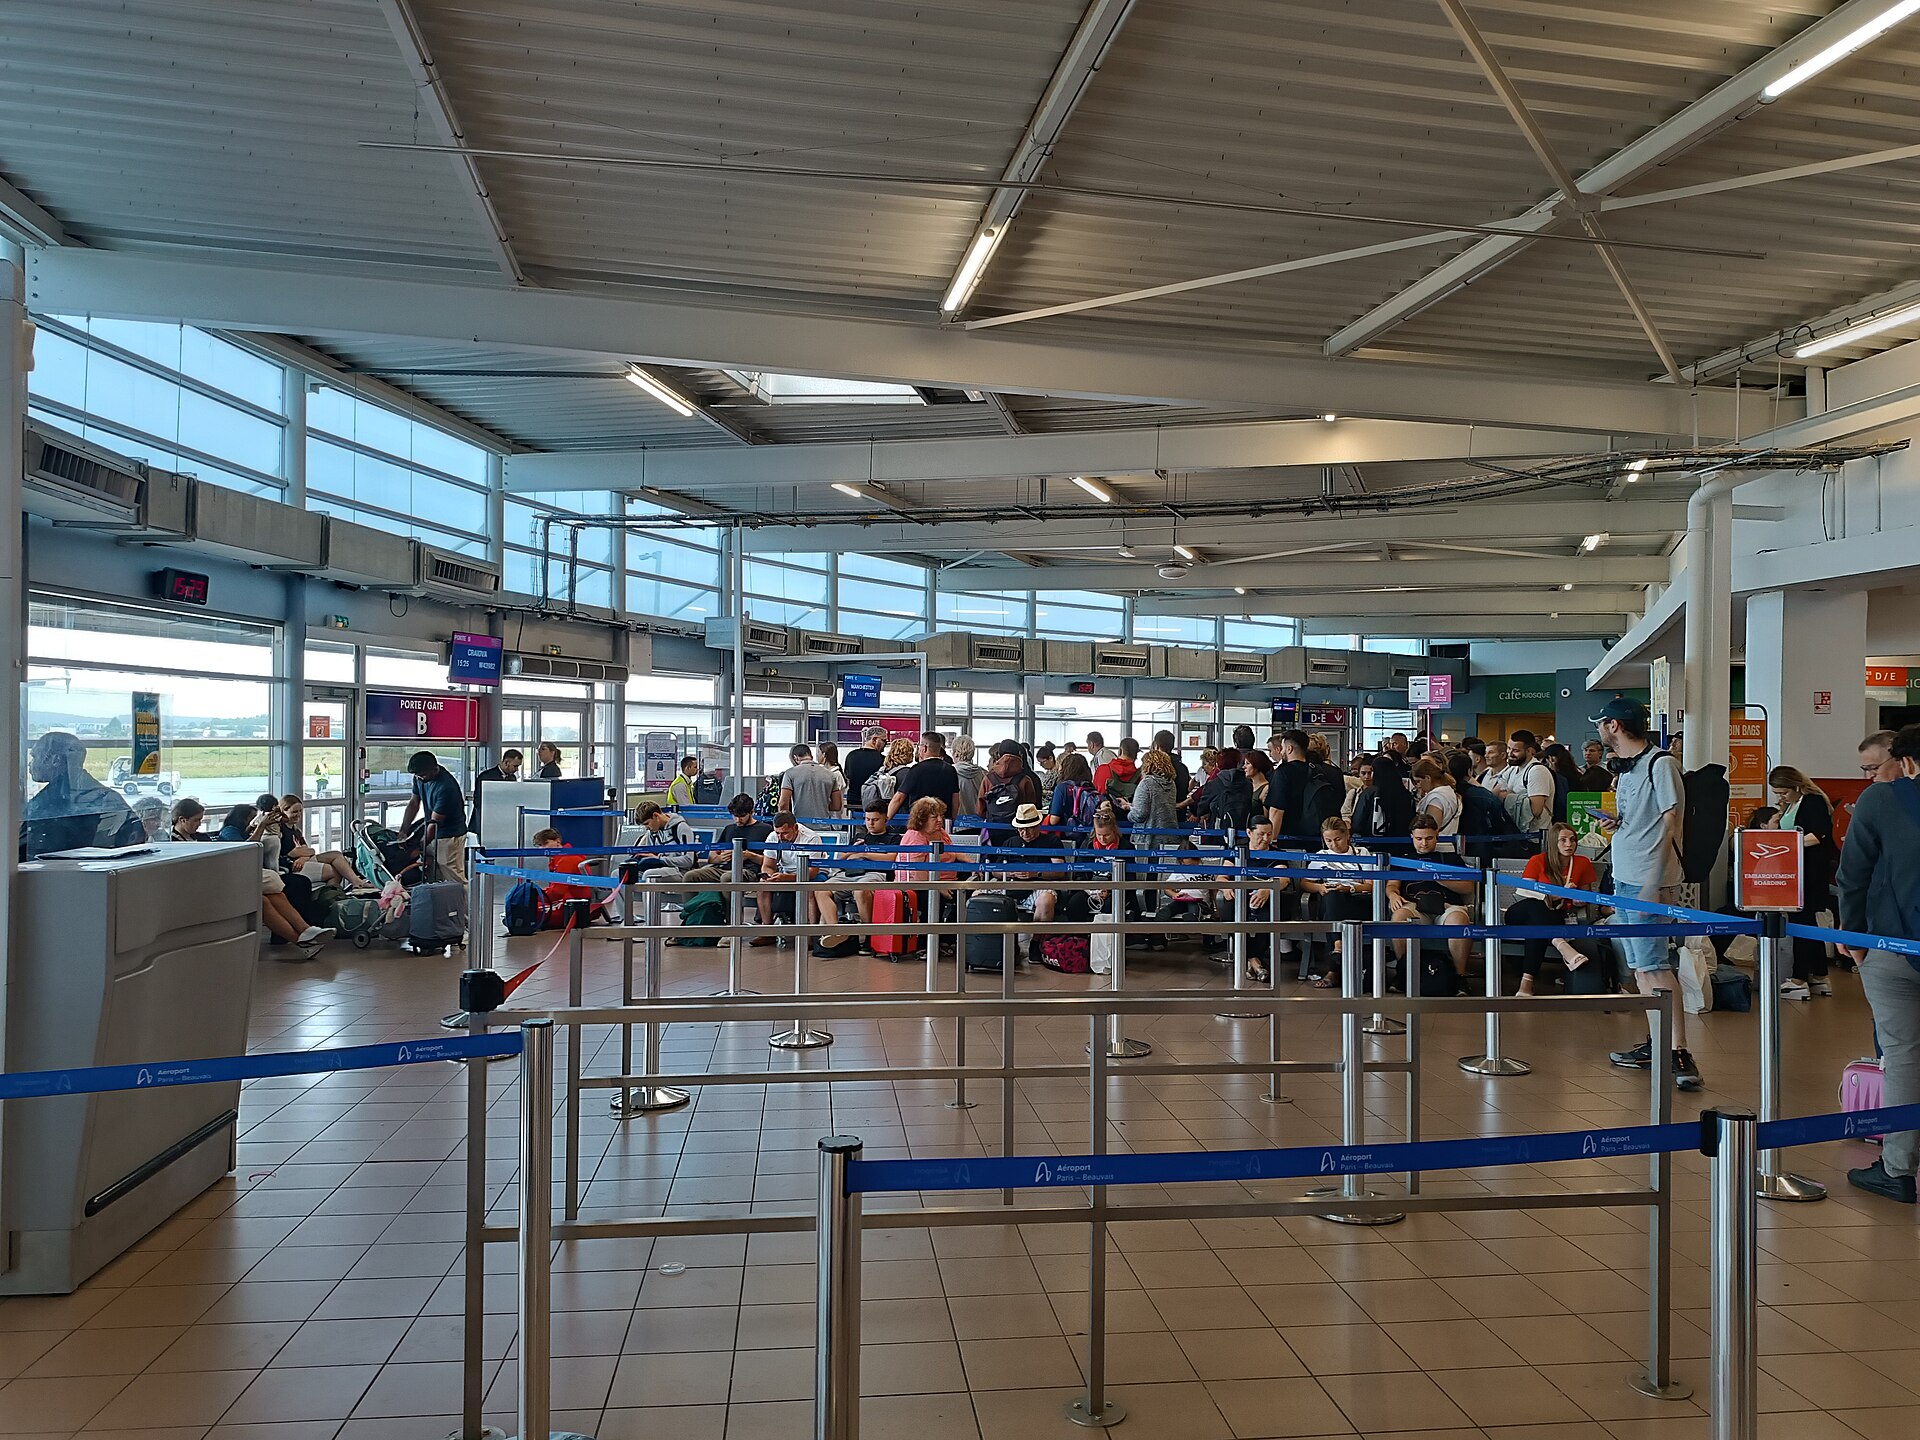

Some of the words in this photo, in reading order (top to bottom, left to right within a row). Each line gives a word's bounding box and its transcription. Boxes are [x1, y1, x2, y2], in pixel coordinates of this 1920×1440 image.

[1499, 688, 1520, 700] café
[400, 700, 422, 710] PORTE
[427, 701, 444, 710] GATE
[417, 712, 427, 734] B
[1743, 725, 1760, 736] BAGS
[1601, 1135, 1630, 1144] Aéroport
[1341, 1153, 1372, 1162] Aéroport
[1057, 1164, 1091, 1172] Aéroport
